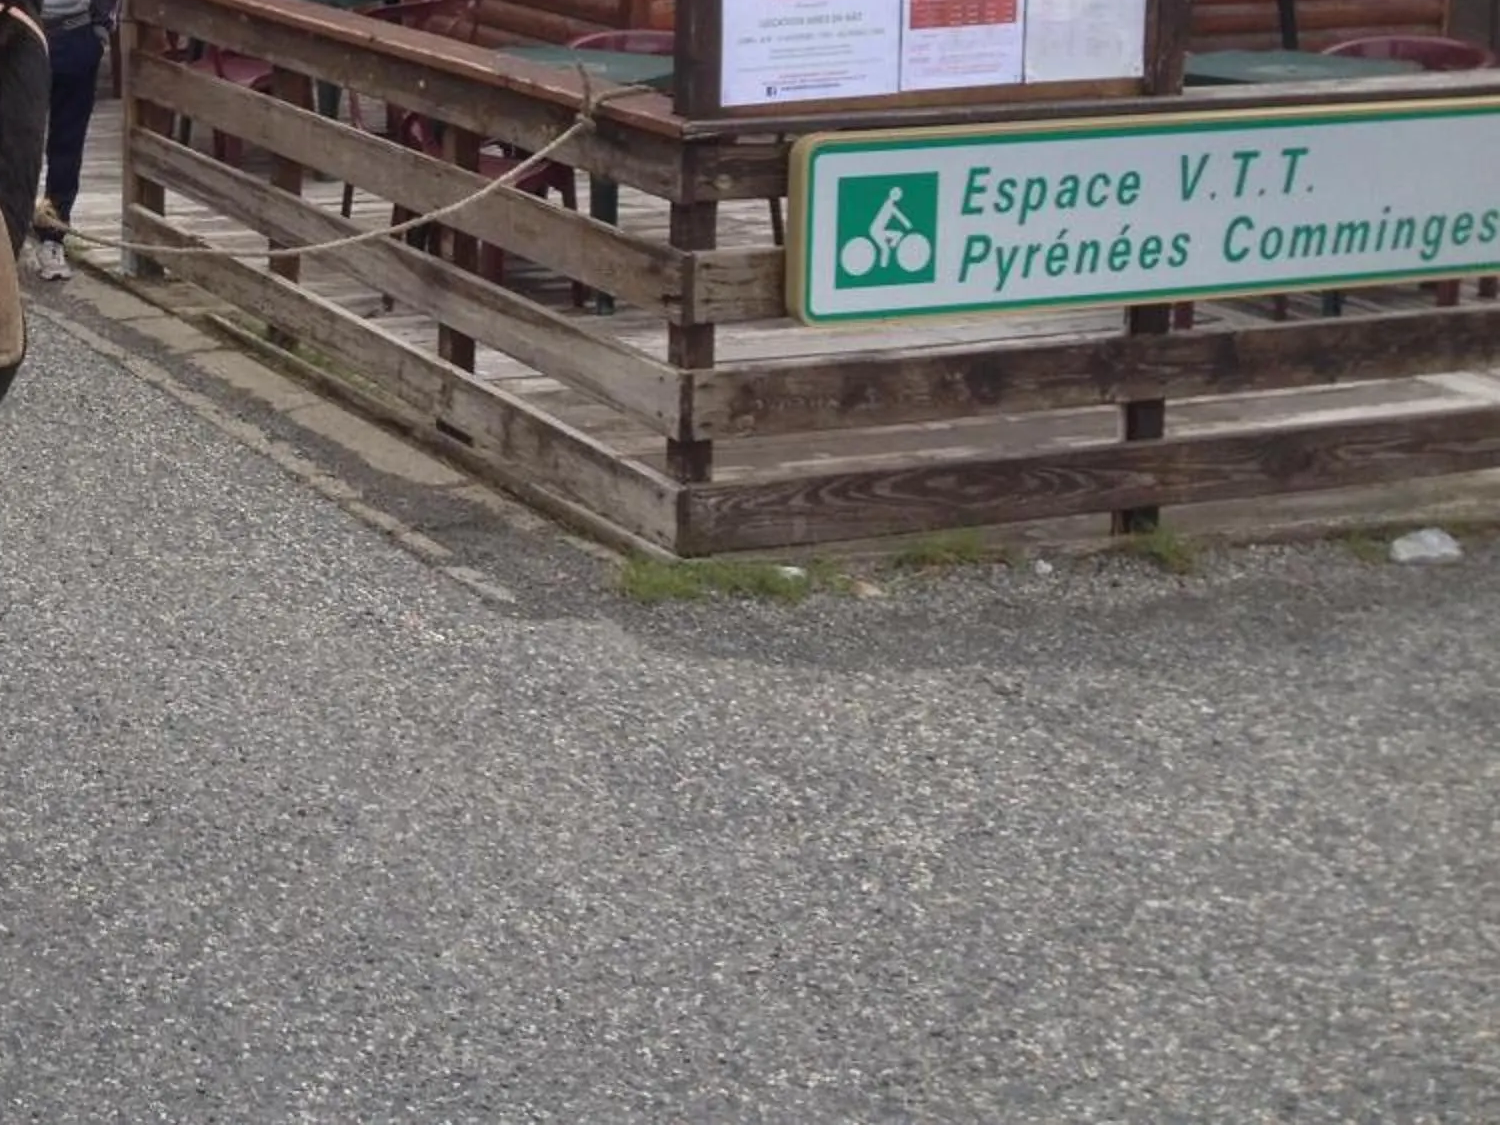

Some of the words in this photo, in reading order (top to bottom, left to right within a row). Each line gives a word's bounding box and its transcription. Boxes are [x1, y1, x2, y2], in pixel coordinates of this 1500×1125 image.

[960, 166, 1142, 225] Espace
[1179, 146, 1316, 202] V.T.T.
[957, 224, 1192, 293] Pyrénées
[1222, 206, 1500, 263] Comminges
